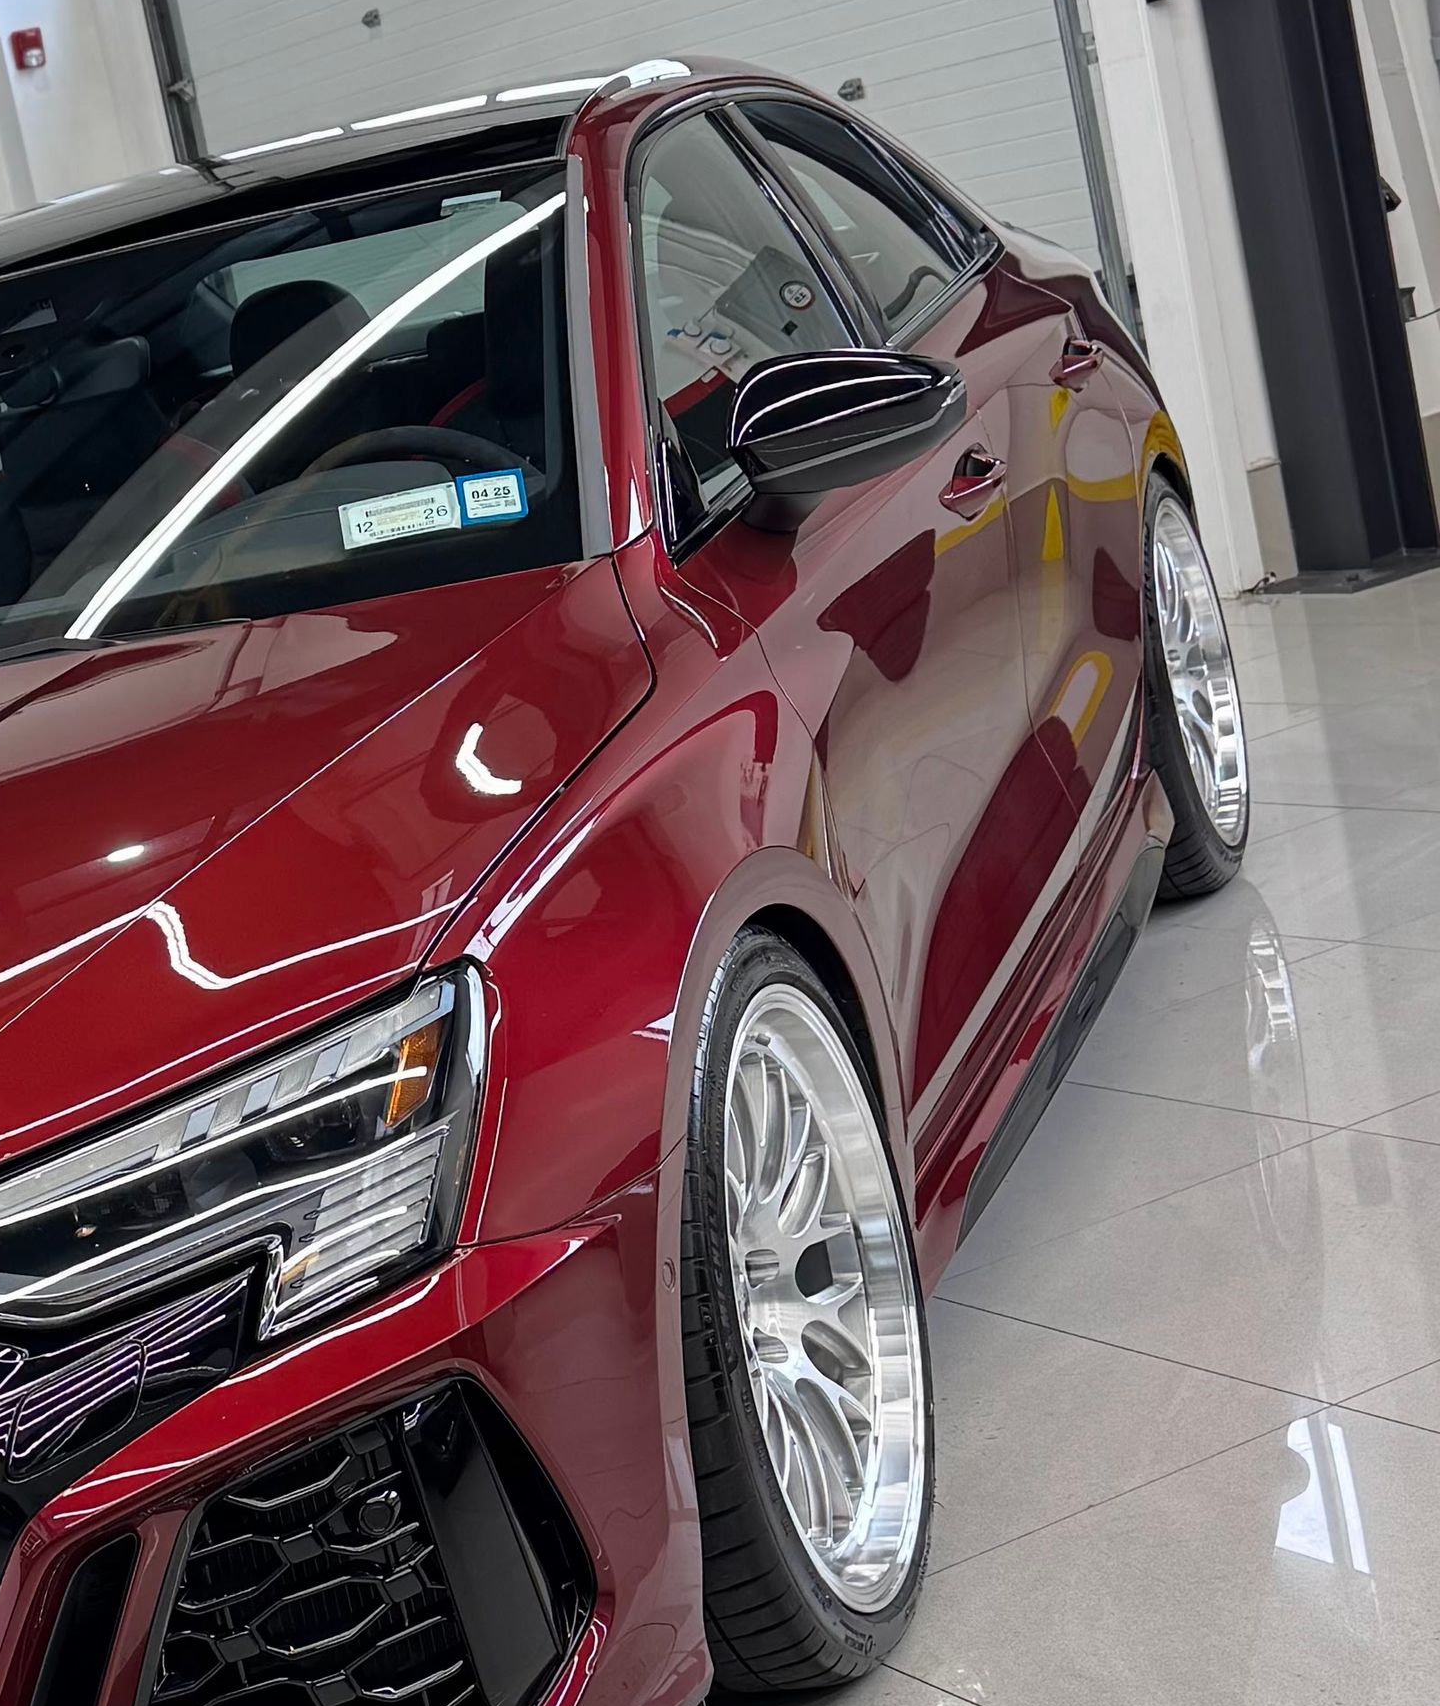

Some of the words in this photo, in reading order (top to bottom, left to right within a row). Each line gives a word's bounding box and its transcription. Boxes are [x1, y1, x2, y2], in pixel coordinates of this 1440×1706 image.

[471, 488, 489, 499] 04
[493, 485, 511, 496] 25
[356, 521, 374, 534] 12
[423, 505, 448, 520] 26
